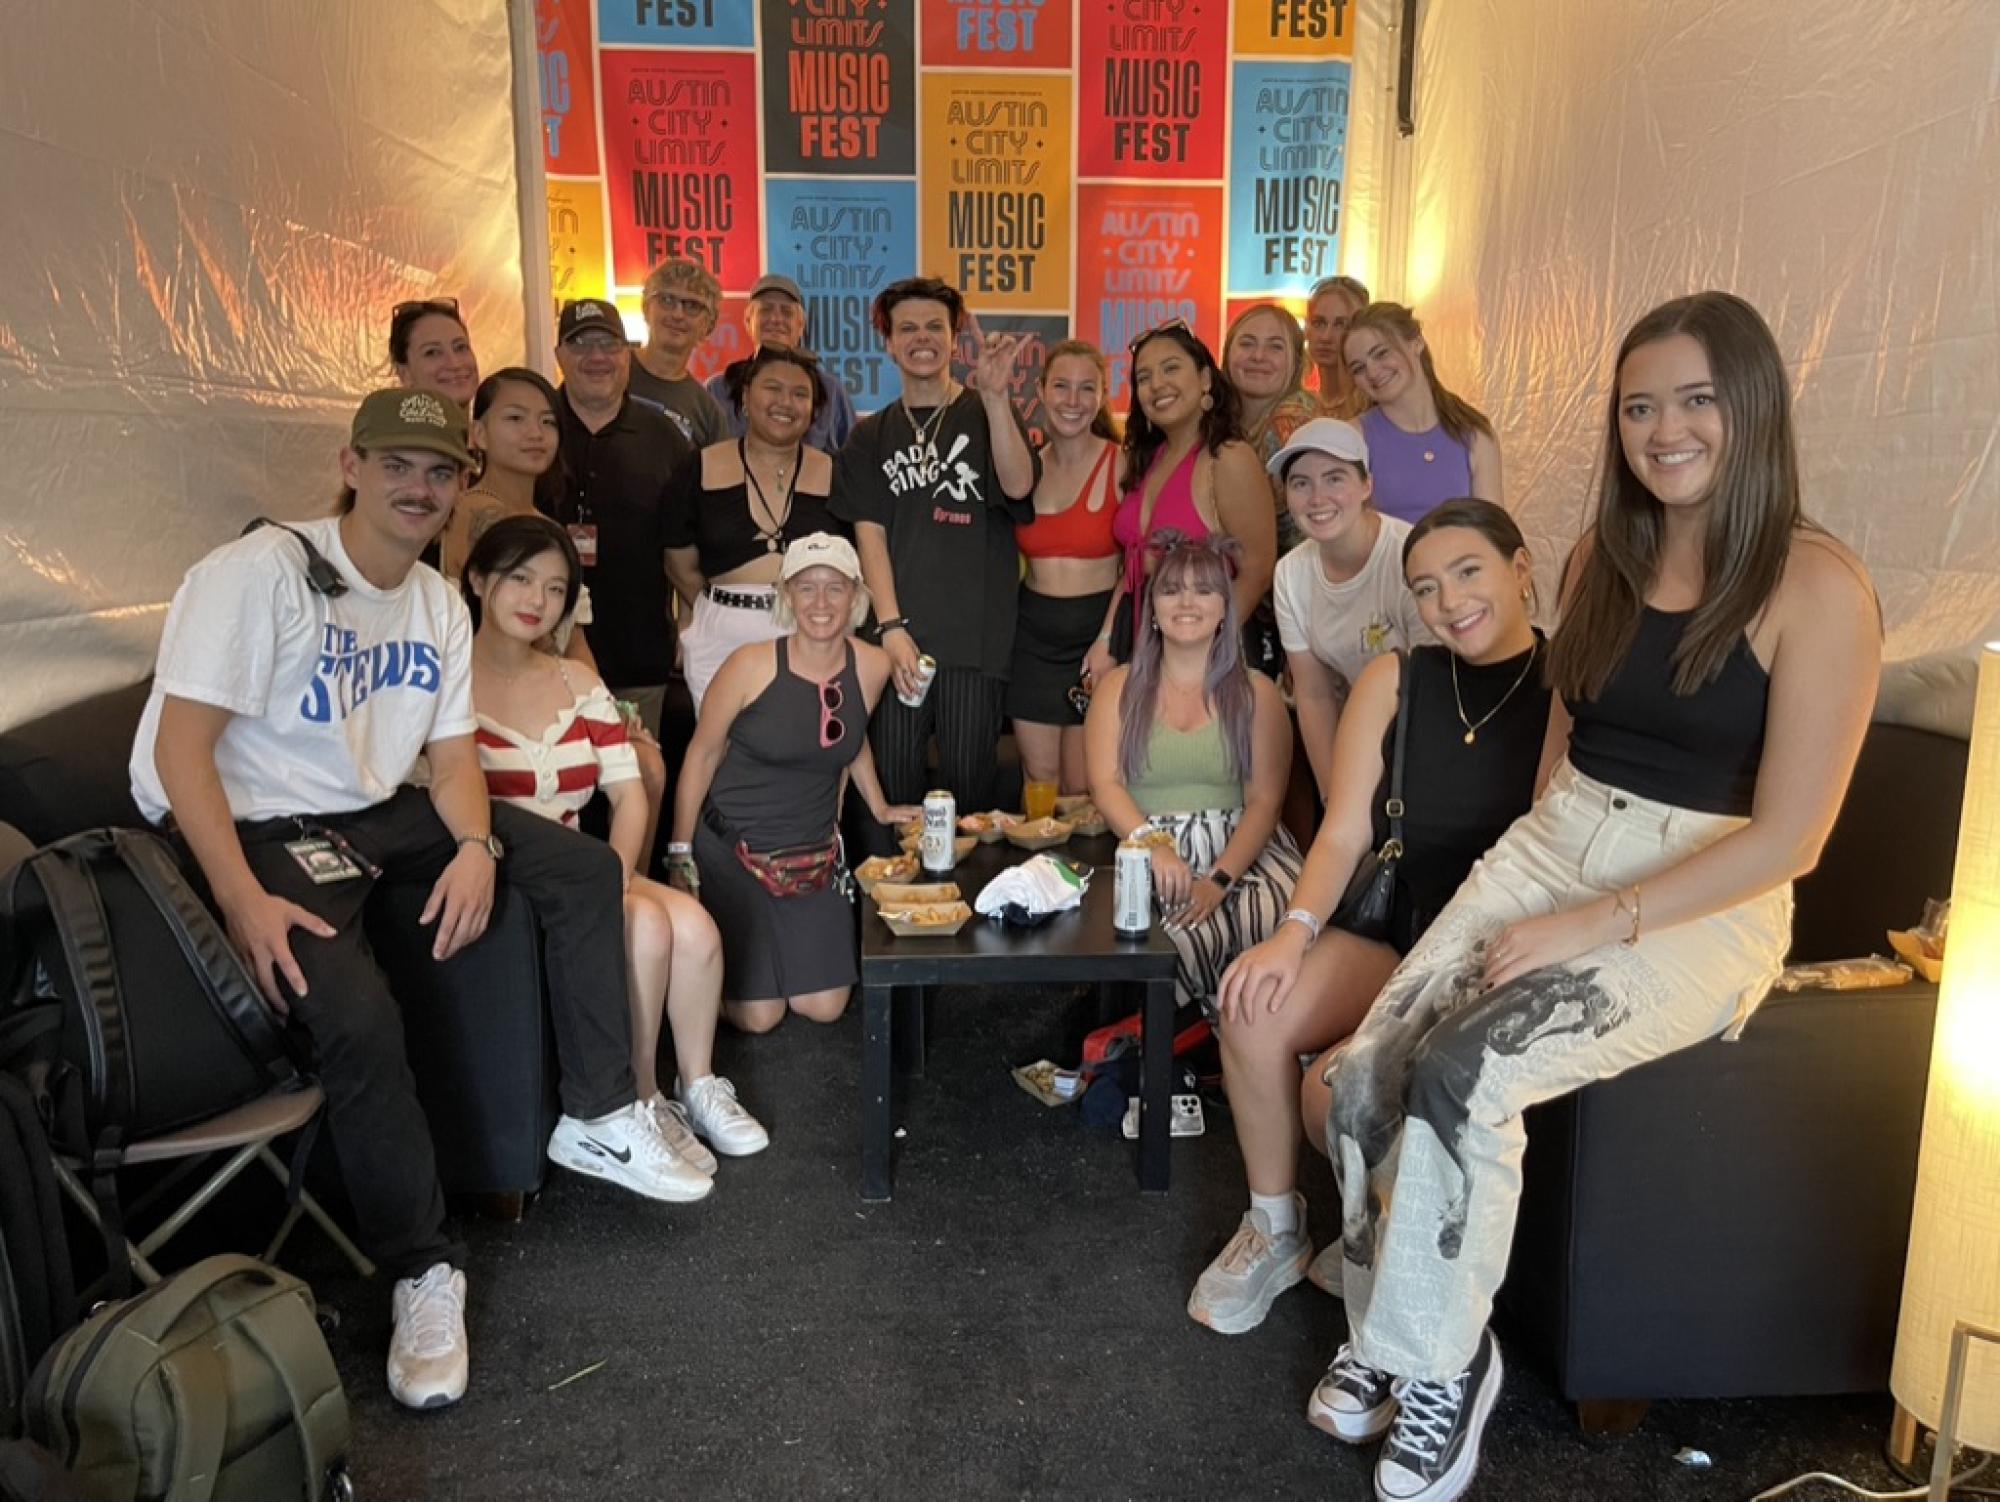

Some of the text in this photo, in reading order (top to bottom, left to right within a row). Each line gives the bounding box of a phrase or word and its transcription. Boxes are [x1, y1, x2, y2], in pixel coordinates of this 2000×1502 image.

[635, 0, 714, 27] FEST
[1123, 0, 1185, 22] CITY
[1270, 0, 1348, 39] FEST
[791, 18, 885, 47] LIMITS
[957, 8, 1038, 52] FEST
[1109, 25, 1199, 52] LIMITS
[628, 78, 732, 107] AUSTIN
[788, 50, 890, 115] MUSIC
[1104, 57, 1201, 120] MUSIC
[946, 99, 1048, 128] AUSTIN
[1255, 87, 1348, 116] AUSTIN
[648, 110, 713, 136] CITY
[801, 116, 882, 159] FEST
[1272, 116, 1335, 143] CITY
[633, 138, 728, 167] LIMITS
[966, 130, 1029, 156] CITY
[1113, 122, 1191, 163] FEST
[952, 157, 1041, 186] LIMITS
[1259, 144, 1341, 172] LIMITS
[632, 170, 733, 232] MUSIC
[1255, 175, 1341, 236] MUSIC
[790, 206, 893, 233] AUSTIN
[948, 191, 1046, 250] MUSIC
[1101, 211, 1200, 238] AUSTIN
[810, 235, 874, 261] CITY
[1117, 240, 1180, 264] CITY
[1264, 237, 1329, 277] FEST
[796, 263, 887, 290] LIMITS
[958, 253, 1036, 292] FEST
[1104, 267, 1192, 293] LIMITS
[882, 443, 939, 480] BADA
[300, 640, 442, 724] STEWS
